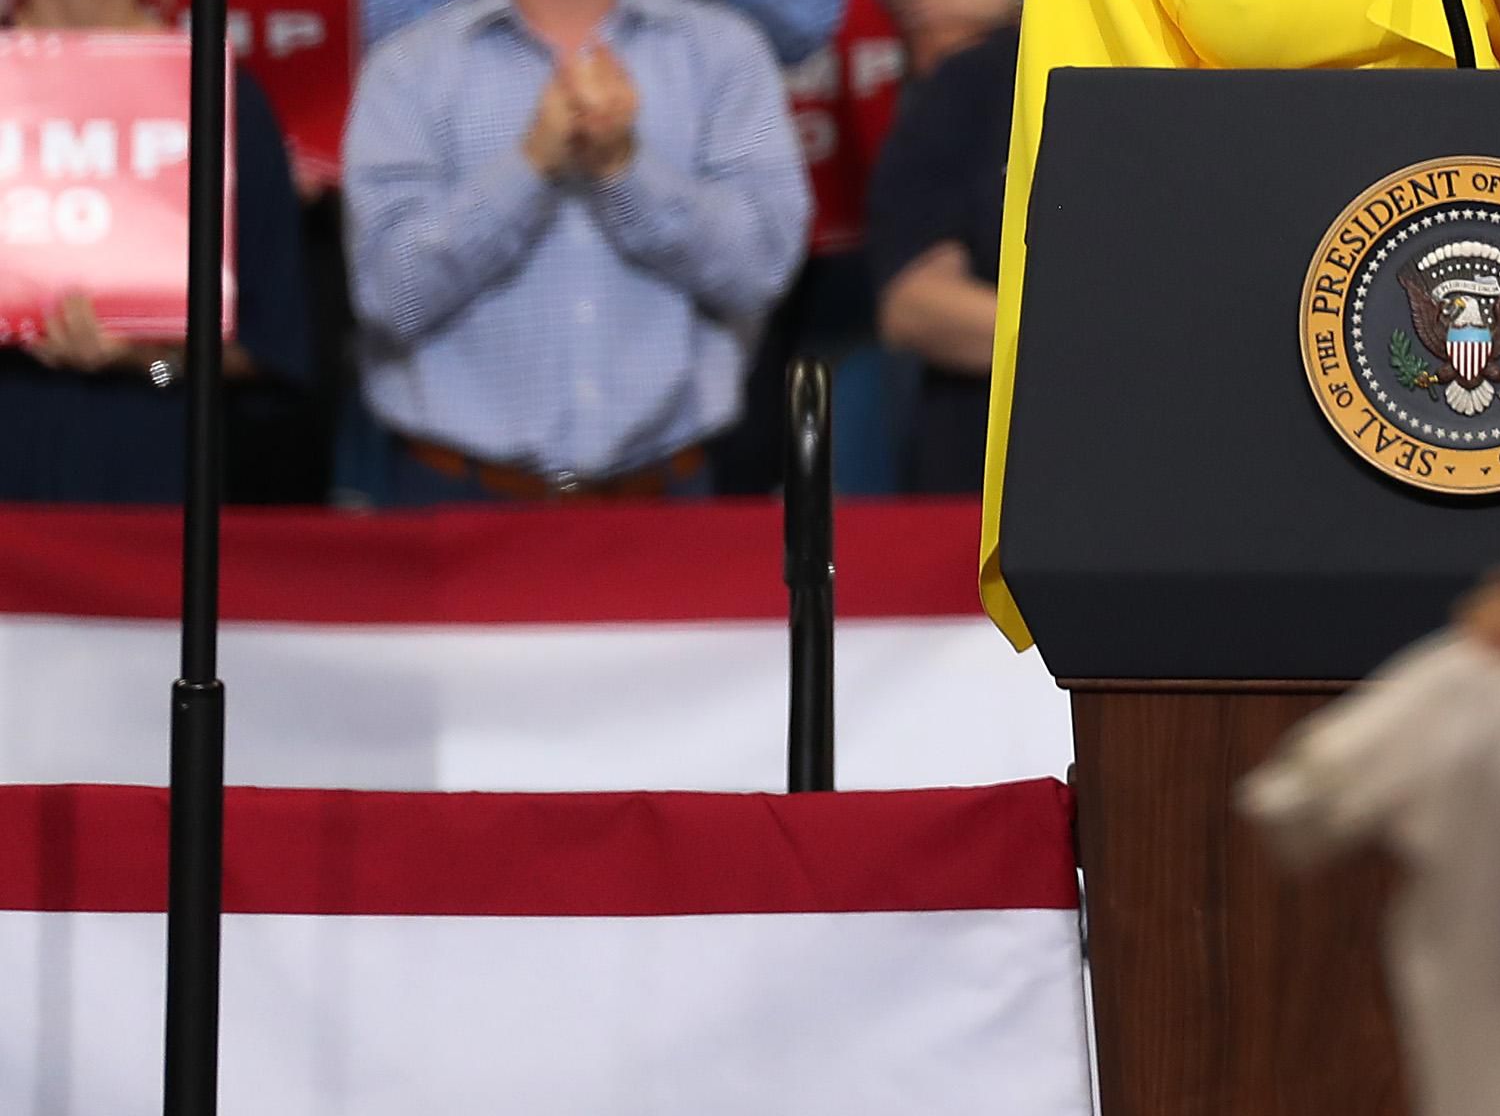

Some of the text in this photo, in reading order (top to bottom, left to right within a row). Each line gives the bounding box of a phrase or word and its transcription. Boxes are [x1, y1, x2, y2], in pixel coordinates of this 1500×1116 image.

[1312, 170, 1460, 317] PRESIDENT
[1315, 330, 1340, 376] THE
[1328, 382, 1354, 408] OF
[1353, 408, 1437, 476] SEAL
